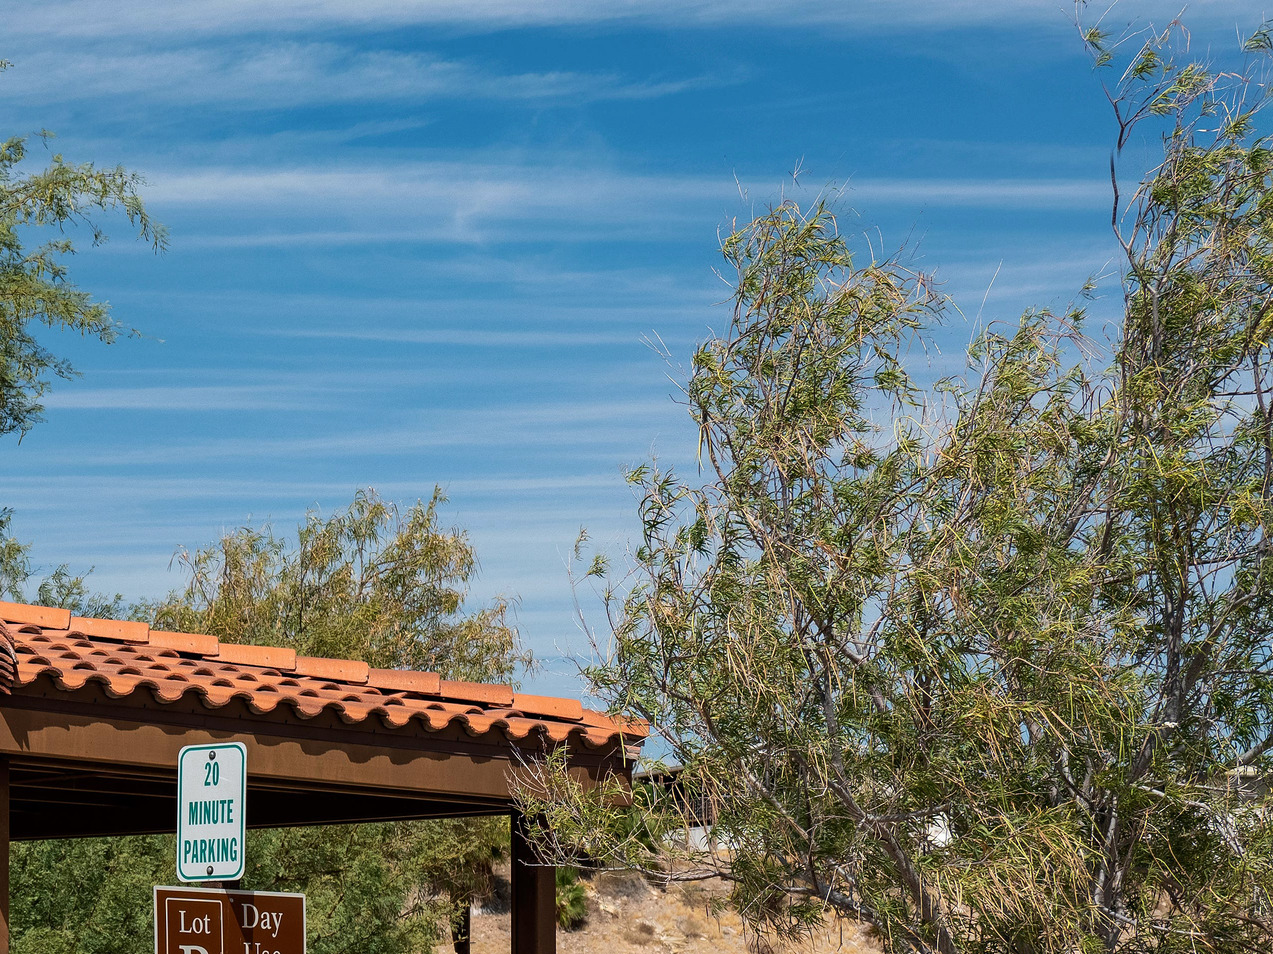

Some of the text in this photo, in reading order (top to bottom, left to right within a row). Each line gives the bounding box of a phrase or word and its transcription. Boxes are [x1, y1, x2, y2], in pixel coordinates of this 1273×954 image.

[204, 761, 220, 787] 20
[188, 799, 234, 826] MINUTE
[184, 837, 238, 864] PARKING
[179, 910, 211, 935] Lot
[241, 903, 284, 938] Day
